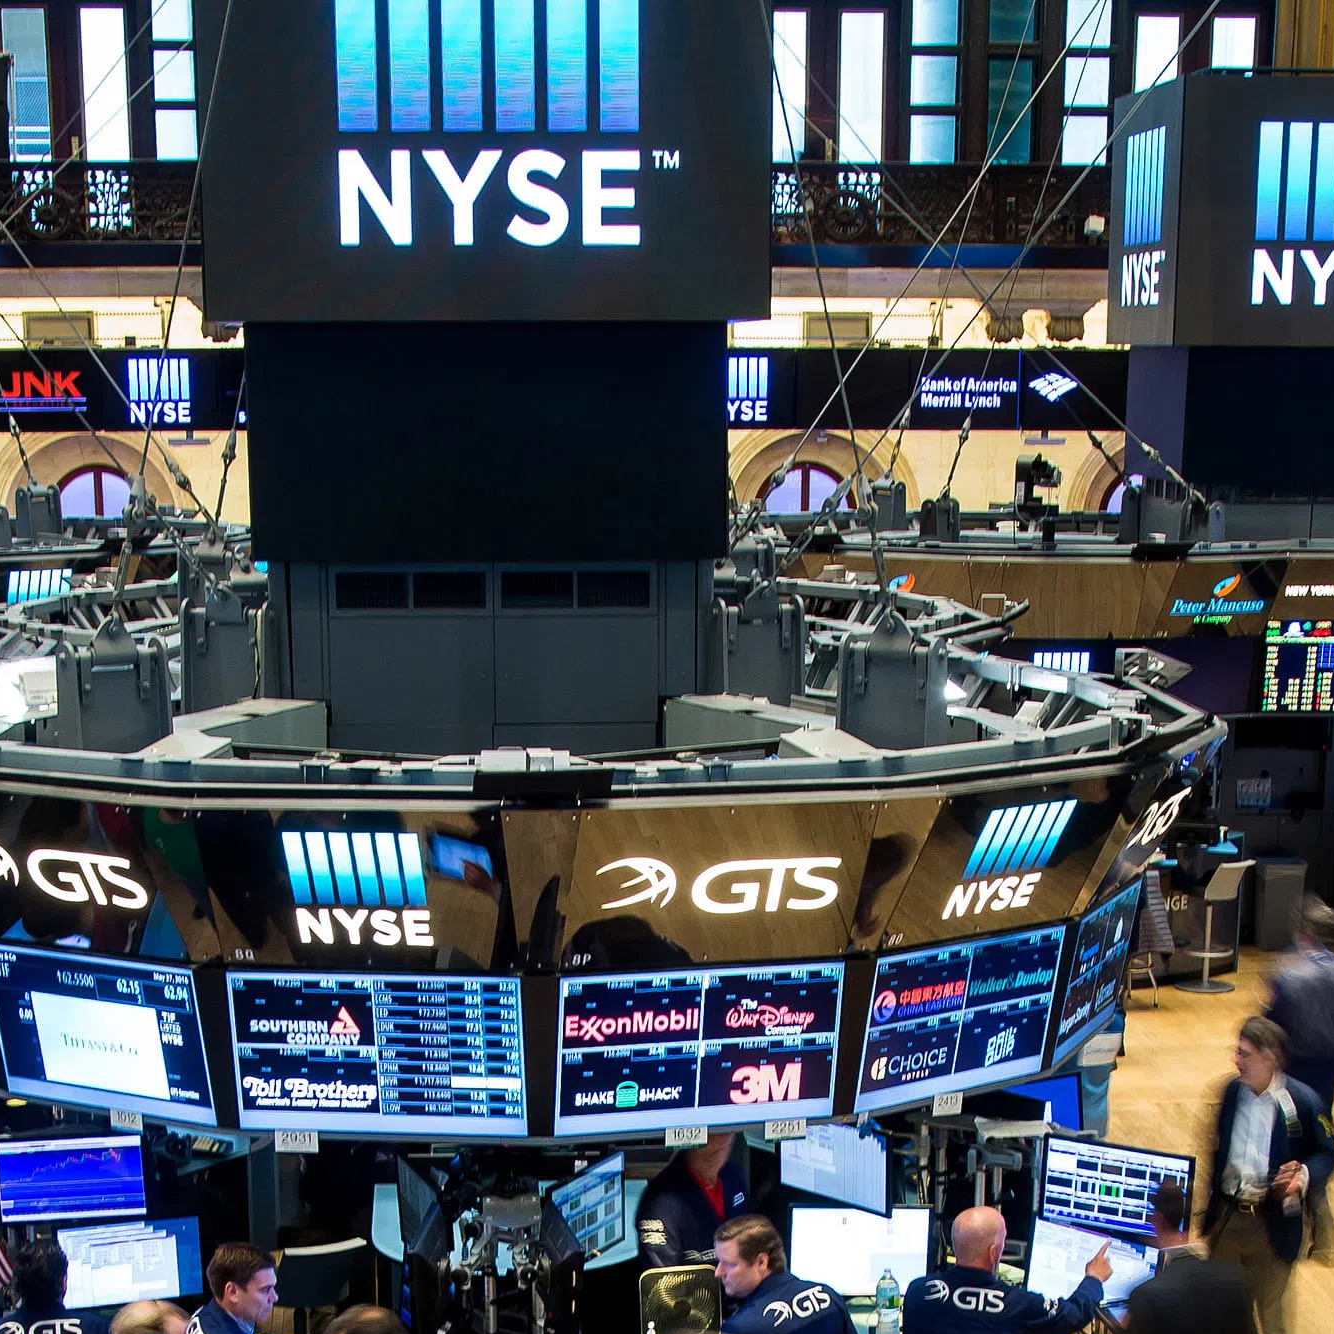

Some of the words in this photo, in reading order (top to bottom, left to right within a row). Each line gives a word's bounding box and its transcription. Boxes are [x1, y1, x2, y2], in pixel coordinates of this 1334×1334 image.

[338, 149, 641, 247] NYSE
[1121, 256, 1160, 307] NYSE
[1, 371, 81, 398] JNK
[130, 402, 191, 424] NYSE
[921, 393, 961, 408] Merrill
[965, 393, 1000, 410] Lynch
[1285, 585, 1308, 597] NEW
[1170, 598, 1208, 616] Peter
[1208, 597, 1264, 613] Mancuso
[26, 847, 148, 910] GTS
[692, 857, 842, 914] GTS
[942, 871, 1042, 921] NYSE
[295, 908, 434, 946] NYSE
[153, 972, 165, 982] May
[741, 999, 758, 1010] The
[162, 1011, 176, 1023] TIF
[250, 1019, 328, 1033] SOUTHERN
[565, 1008, 699, 1042] ExxonMobil
[287, 1033, 360, 1045] COMPANY
[765, 1025, 803, 1036] Company
[888, 1047, 947, 1075] CHOICE
[242, 1076, 281, 1097] Toll
[284, 1078, 377, 1100] Brothers
[730, 1062, 802, 1104] 3M
[575, 1090, 615, 1106] SHAKE
[639, 1086, 679, 1102] SHACK
[281, 1132, 312, 1144] 2031
[792, 1285, 831, 1320] GTS
[952, 1289, 1006, 1314] GTS
